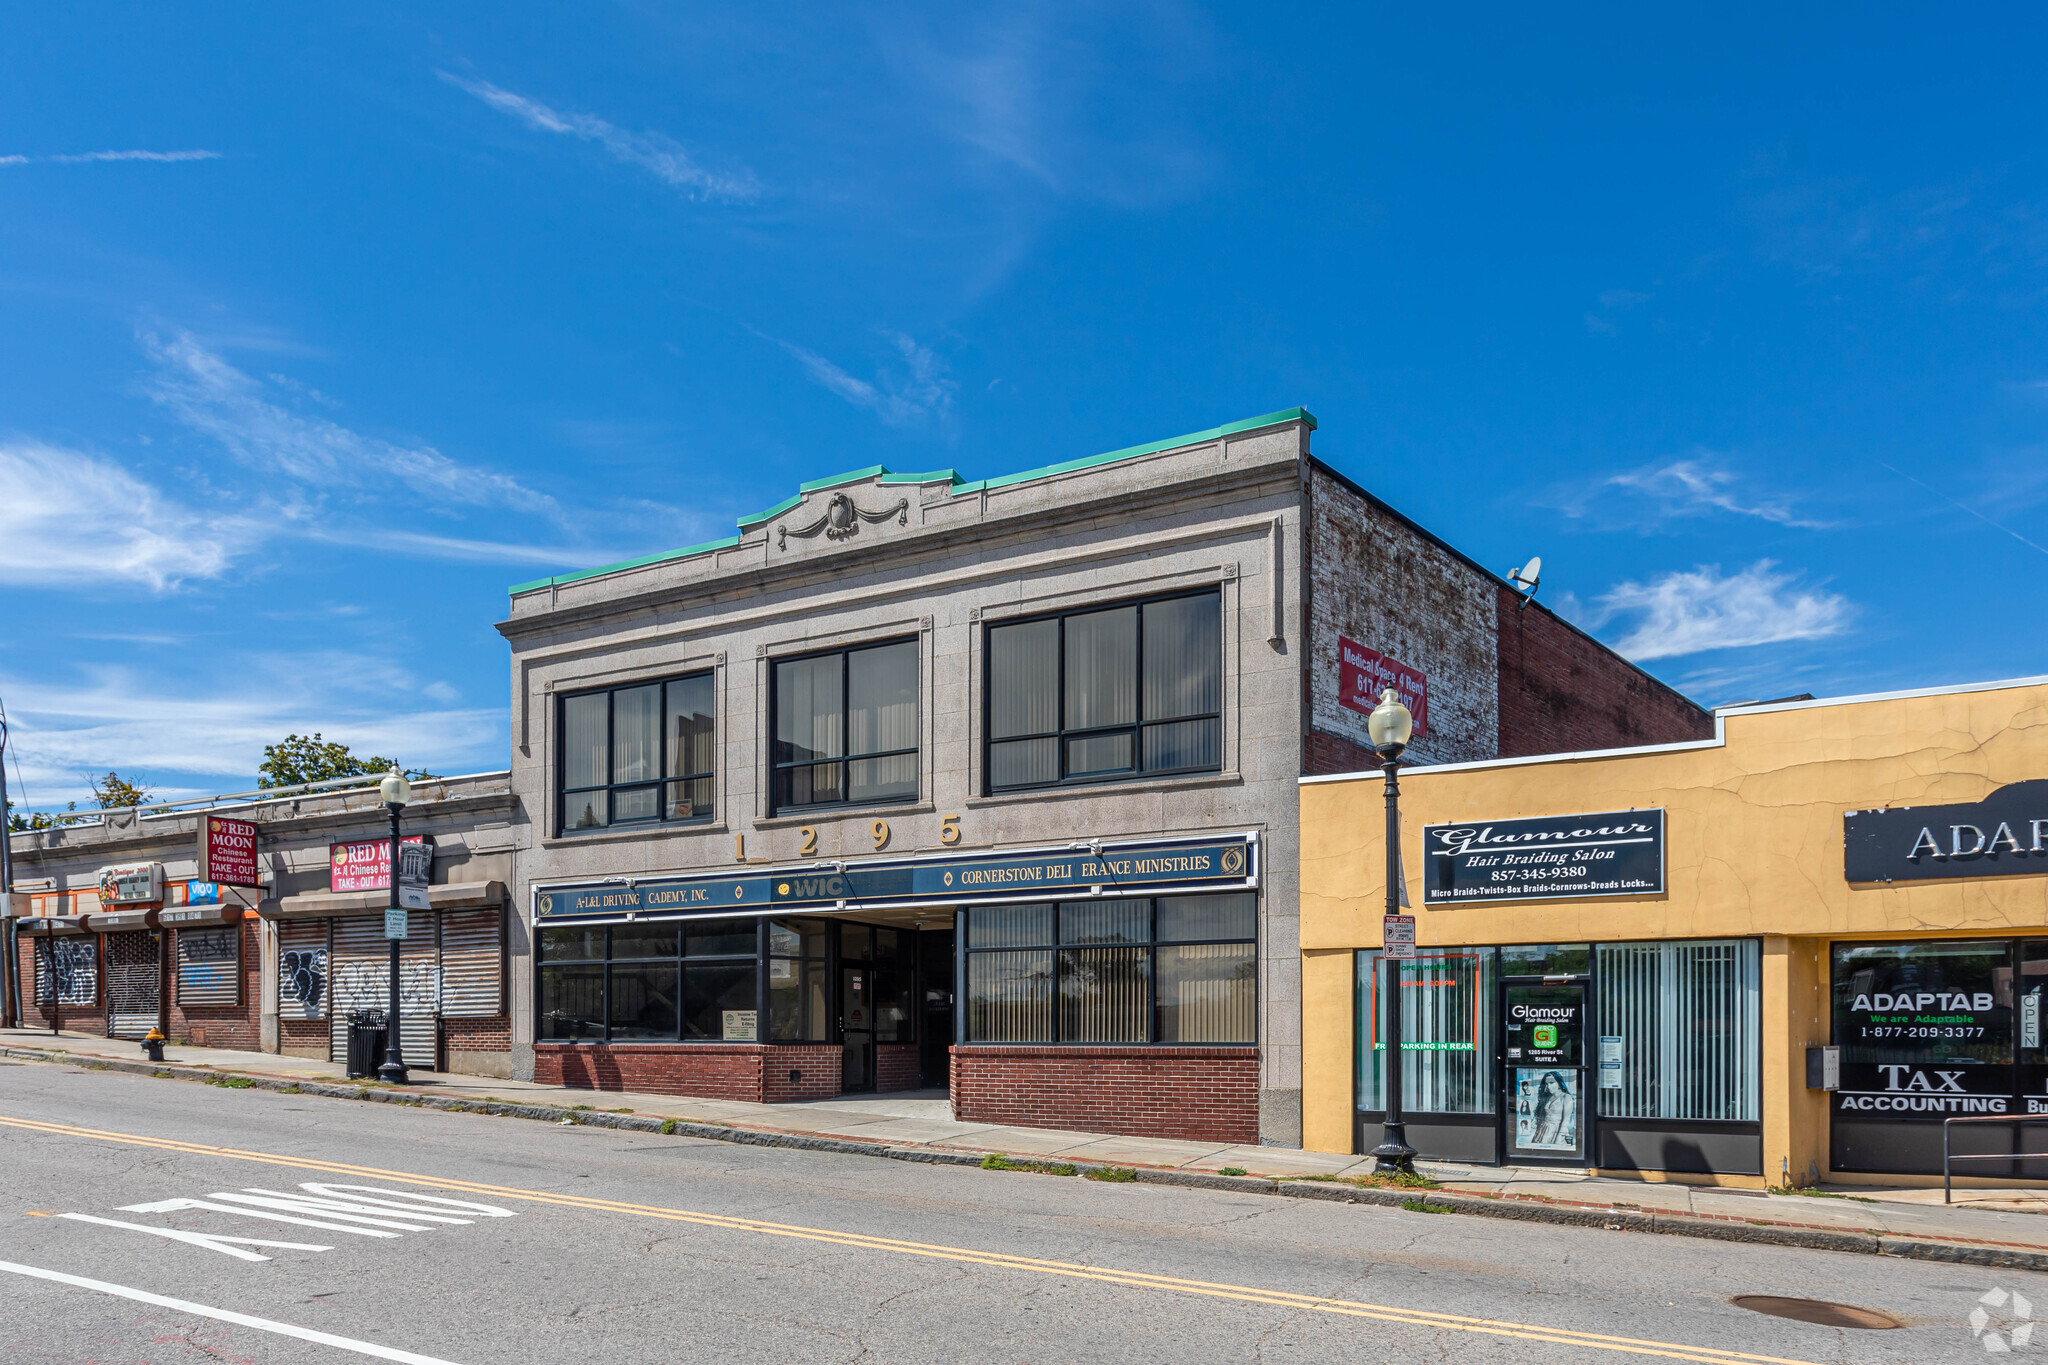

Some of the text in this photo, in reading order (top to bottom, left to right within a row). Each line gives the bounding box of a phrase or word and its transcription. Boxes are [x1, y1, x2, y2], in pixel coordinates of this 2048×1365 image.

[1344, 646, 1424, 696] Medical Space 4 Rent
[228, 823, 255, 836] RED
[212, 834, 252, 848] MOON
[1432, 823, 1653, 856] Glamour
[212, 854, 253, 864] Restaurant
[217, 847, 248, 857] Chinese
[348, 844, 375, 863] RED
[1465, 849, 1615, 867] Hair Braiding Salon
[211, 863, 232, 873] TAKE
[238, 866, 255, 875] OUT
[350, 864, 378, 876] Chinese
[961, 867, 1042, 884] CORNERSTONE
[1134, 855, 1210, 874] MINISTRIES
[1491, 866, 1587, 881] 857-345-9380
[211, 873, 255, 883] 617-361-1788
[338, 878, 355, 889] TAKE
[360, 876, 374, 888] OUT
[191, 883, 213, 897] vigo
[793, 877, 844, 897] WIC
[1431, 889, 1452, 897] Micro
[603, 893, 640, 907] DRIVING
[648, 890, 688, 904] CADEMY,
[691, 889, 709, 902] INC.
[1851, 993, 1994, 1012] ADAPTAB
[1512, 1005, 1575, 1018] Glamour
[1870, 1015, 1887, 1023] We
[1914, 1014, 1974, 1024] Adaptable
[2023, 996, 2036, 1047] OPEN
[1535, 1031, 1549, 1041] G
[1861, 1027, 1984, 1037] 1-877-209-3377
[1841, 1097, 2007, 1112] ACCOUNTING
